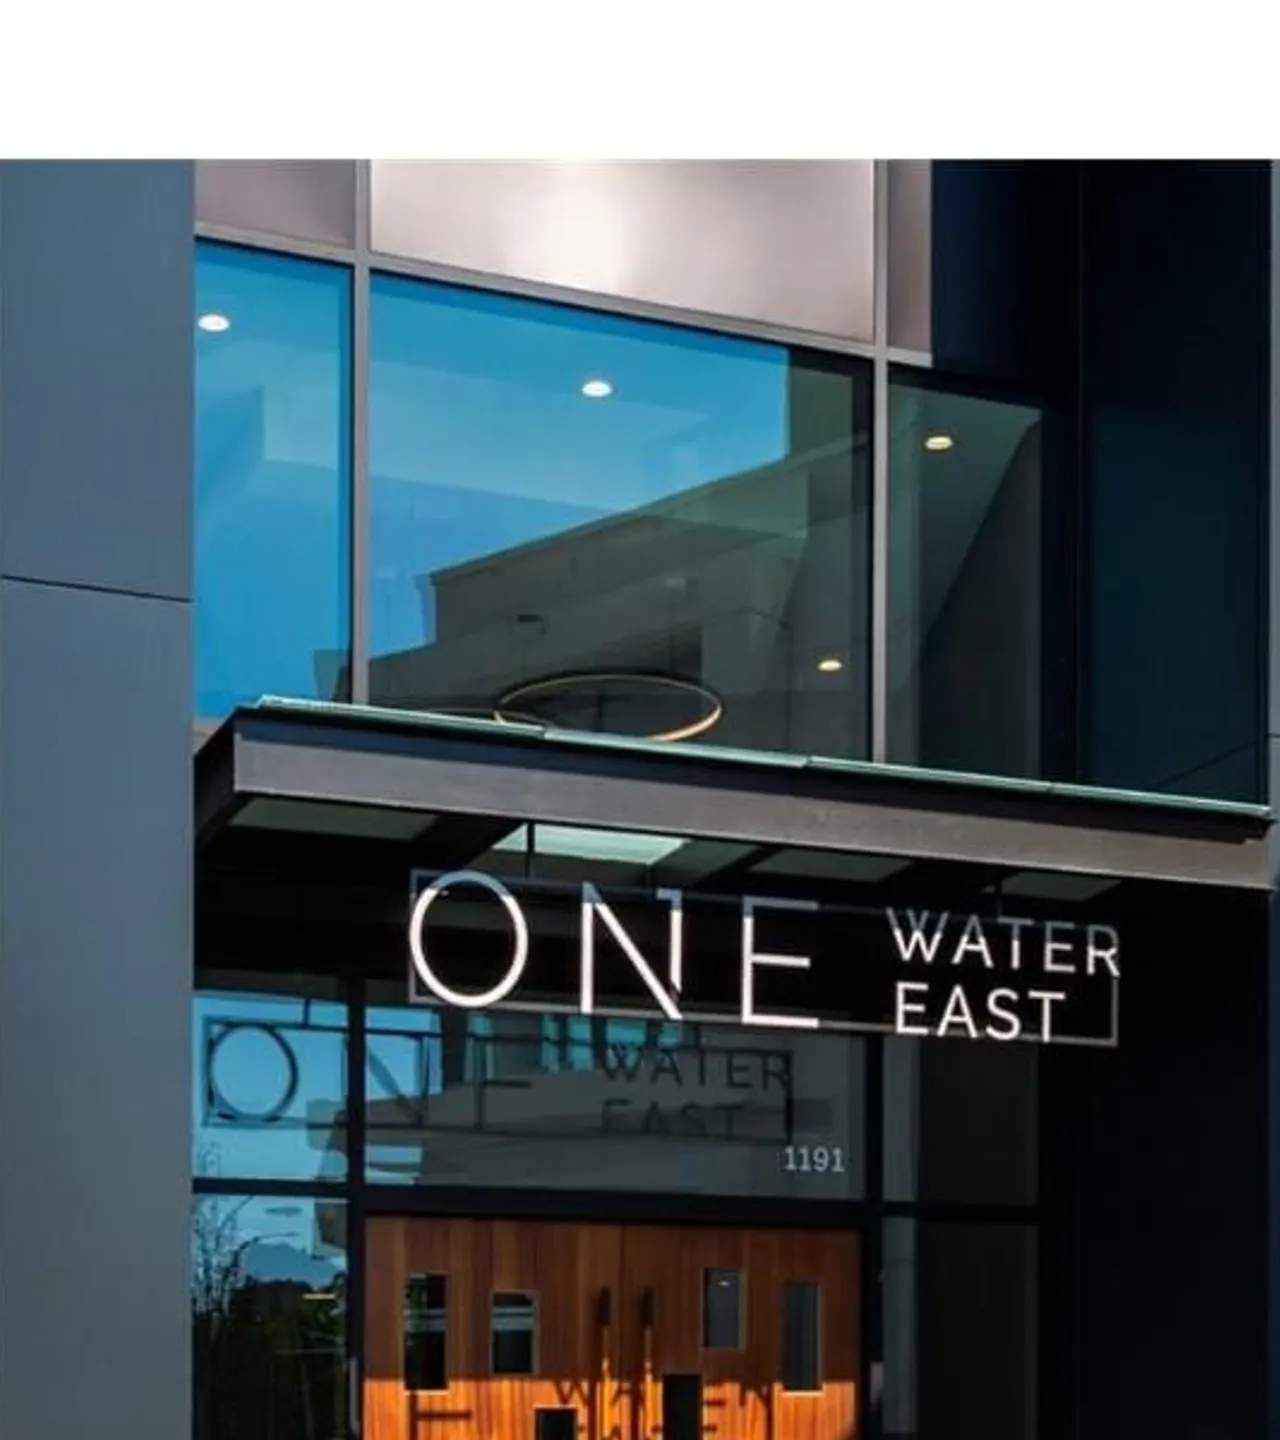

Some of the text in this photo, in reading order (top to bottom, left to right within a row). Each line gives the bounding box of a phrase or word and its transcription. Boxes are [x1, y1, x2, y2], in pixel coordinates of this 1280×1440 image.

[409, 870, 819, 1029] ONE
[885, 906, 1121, 978] WATER
[895, 980, 1066, 1042] EAST
[784, 1146, 846, 1173] 1191
